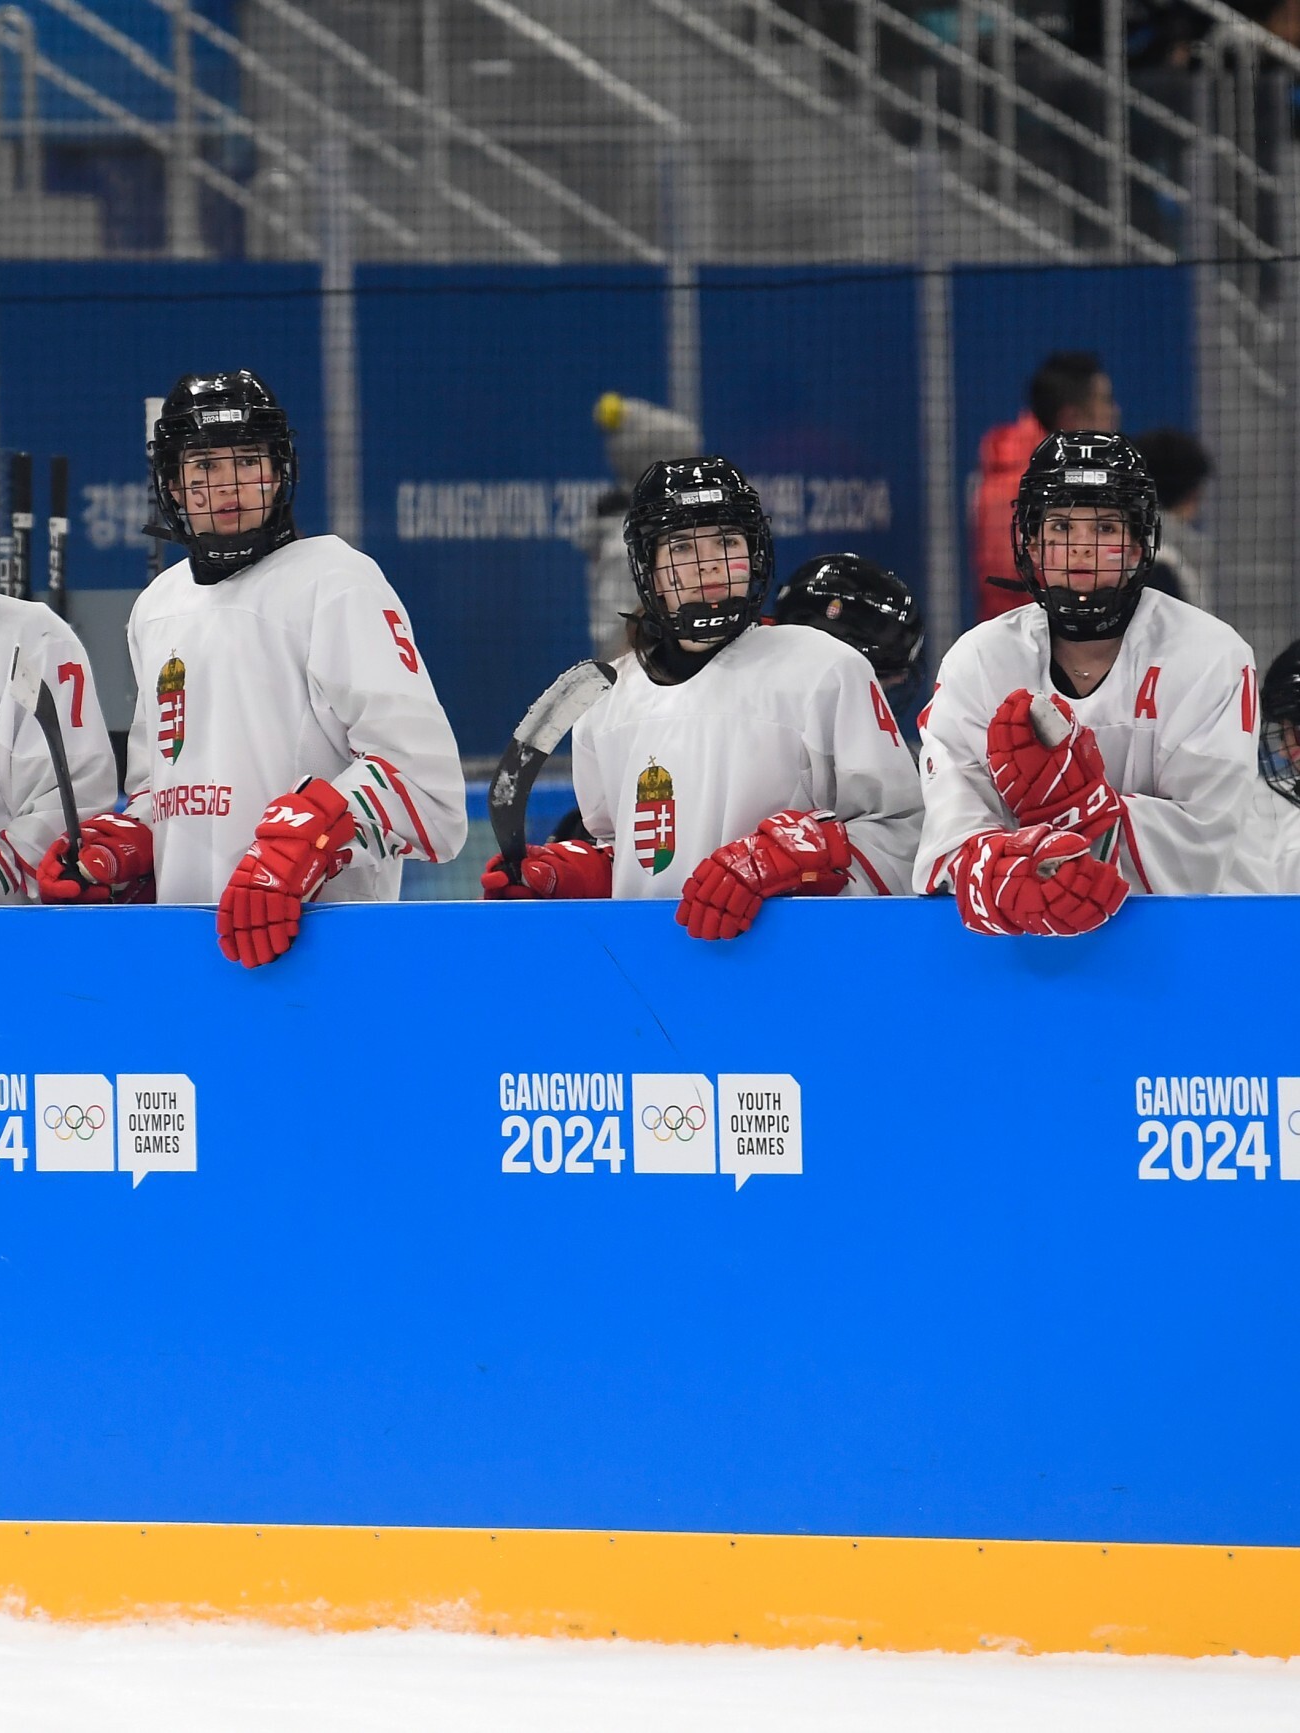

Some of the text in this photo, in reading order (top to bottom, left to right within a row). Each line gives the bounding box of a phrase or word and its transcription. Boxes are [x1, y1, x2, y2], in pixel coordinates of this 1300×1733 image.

[213, 379, 224, 391] 5
[202, 415, 219, 424] 2024
[692, 467, 703, 479] 4
[208, 548, 253, 559] CCM
[693, 613, 740, 628] CCM
[382, 609, 418, 675] 5
[57, 661, 85, 728] 7
[1134, 666, 1161, 719] A
[869, 680, 900, 747] 4
[260, 805, 315, 828] CM
[135, 1092, 177, 1109] YOUTH
[500, 1072, 624, 1111] GANGWON
[1135, 1076, 1269, 1116] GANGWON
[737, 1092, 781, 1110] YOUTH
[128, 1114, 185, 1132] OLYMPIC
[730, 1115, 790, 1133] OLYMPIC
[134, 1136, 180, 1153] GAMES
[501, 1115, 626, 1174] 2024
[736, 1137, 785, 1155] GAMES
[1137, 1120, 1272, 1181] 2024
